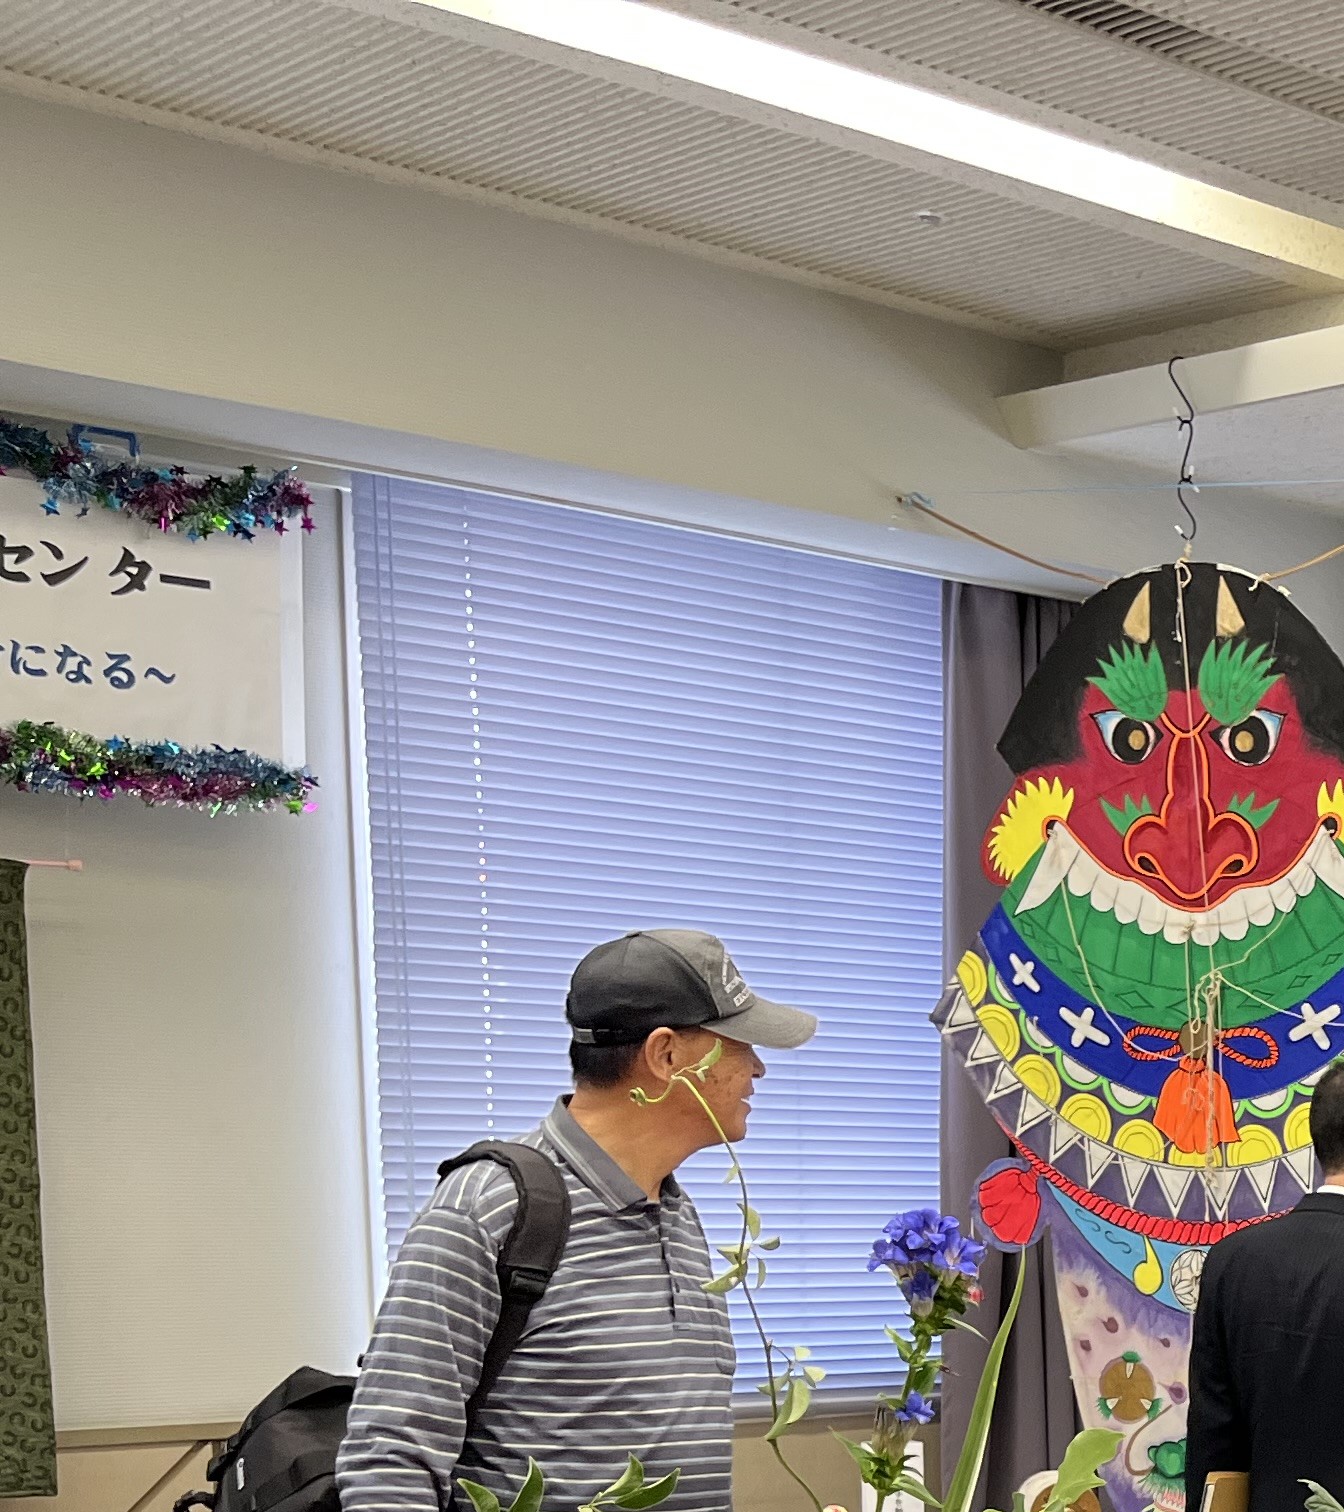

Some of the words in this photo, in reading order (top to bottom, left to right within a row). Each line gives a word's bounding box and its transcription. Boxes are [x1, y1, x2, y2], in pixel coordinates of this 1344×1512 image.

[0, 534, 211, 595] センター
[0, 639, 176, 690] になる～
